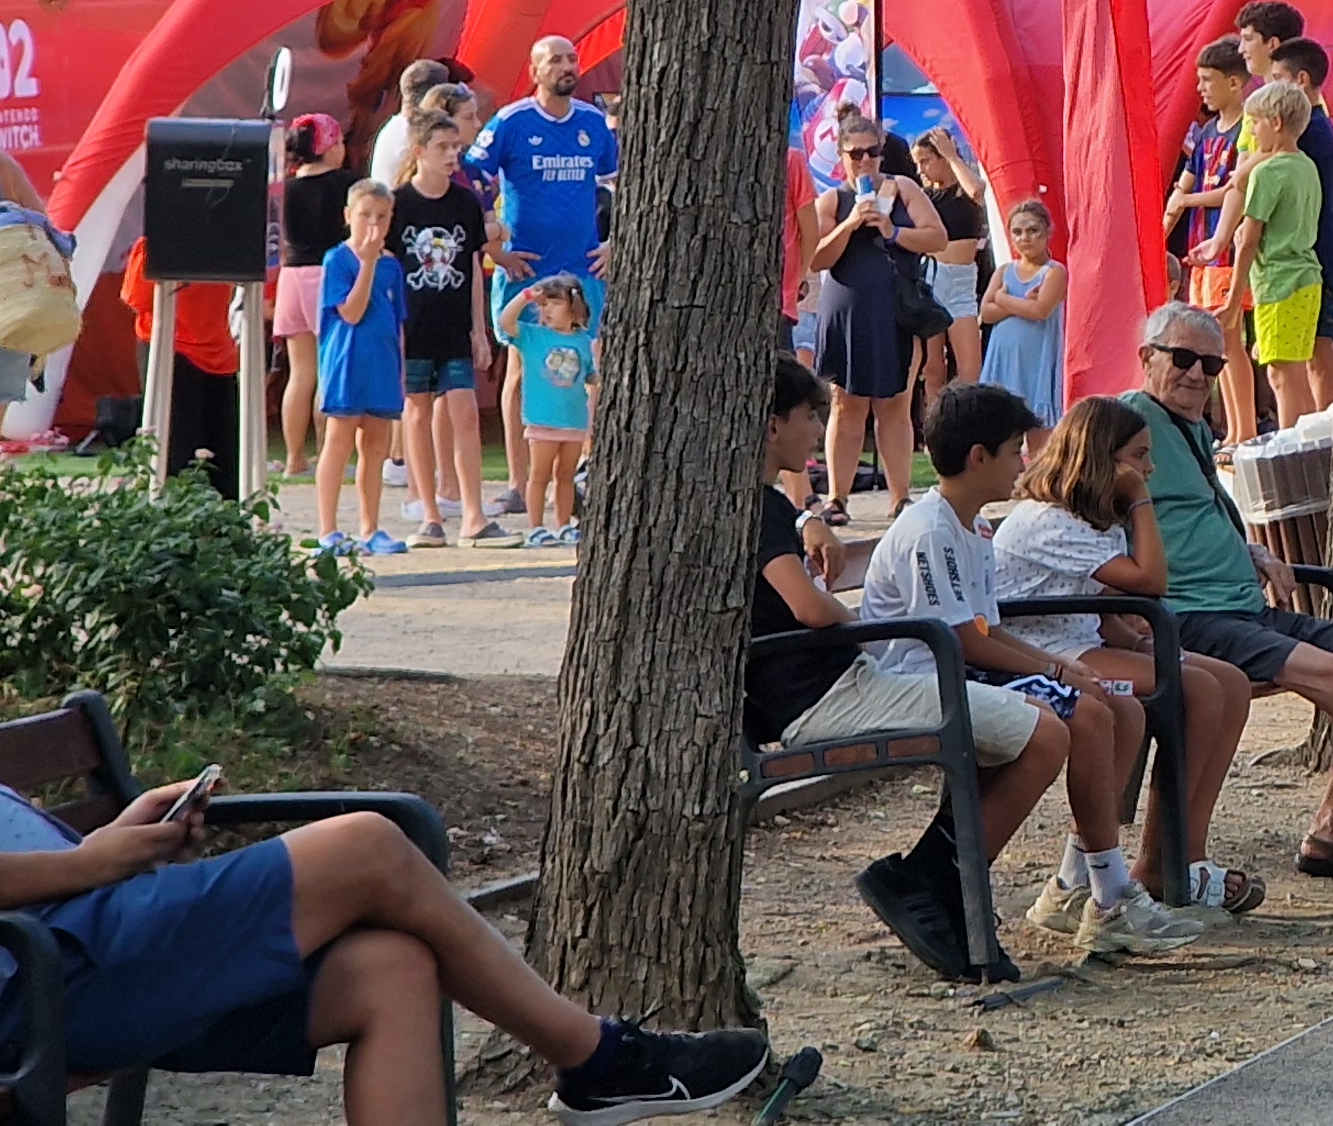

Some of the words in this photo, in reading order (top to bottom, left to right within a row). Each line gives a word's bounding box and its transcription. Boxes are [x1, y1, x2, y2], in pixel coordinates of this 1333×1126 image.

[532, 154, 595, 171] Emirates
[916, 551, 940, 607] NETSHOES
[943, 546, 966, 603] NETSHOES
